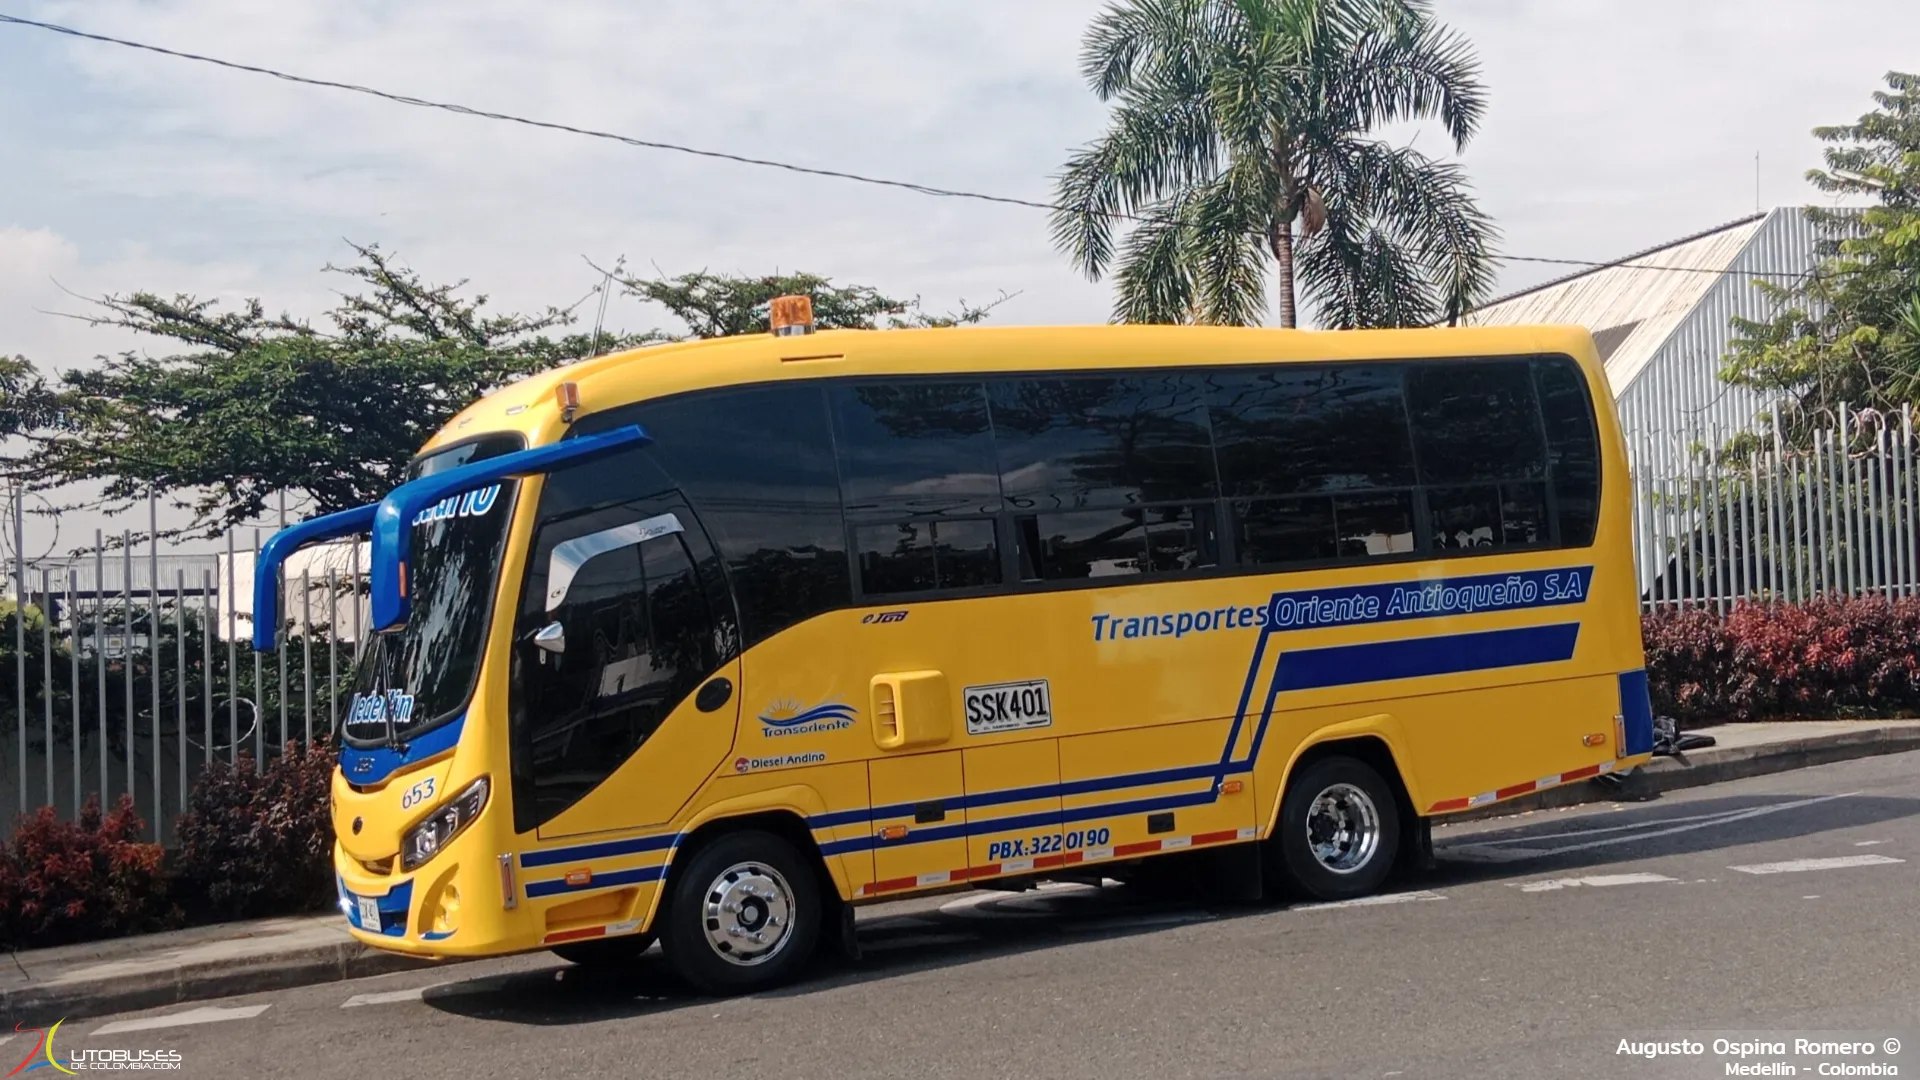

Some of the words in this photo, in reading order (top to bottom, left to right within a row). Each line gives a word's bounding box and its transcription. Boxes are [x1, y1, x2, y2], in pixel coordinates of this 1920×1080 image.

[1091, 604, 1270, 641] Transportes
[1274, 593, 1380, 627] Oriente
[1385, 575, 1538, 615] Antioqueño
[967, 687, 1047, 723] SSK401
[761, 720, 850, 738] Transoriente
[751, 756, 783, 769] Diesel
[786, 753, 826, 765] Andino
[402, 778, 435, 809] 653
